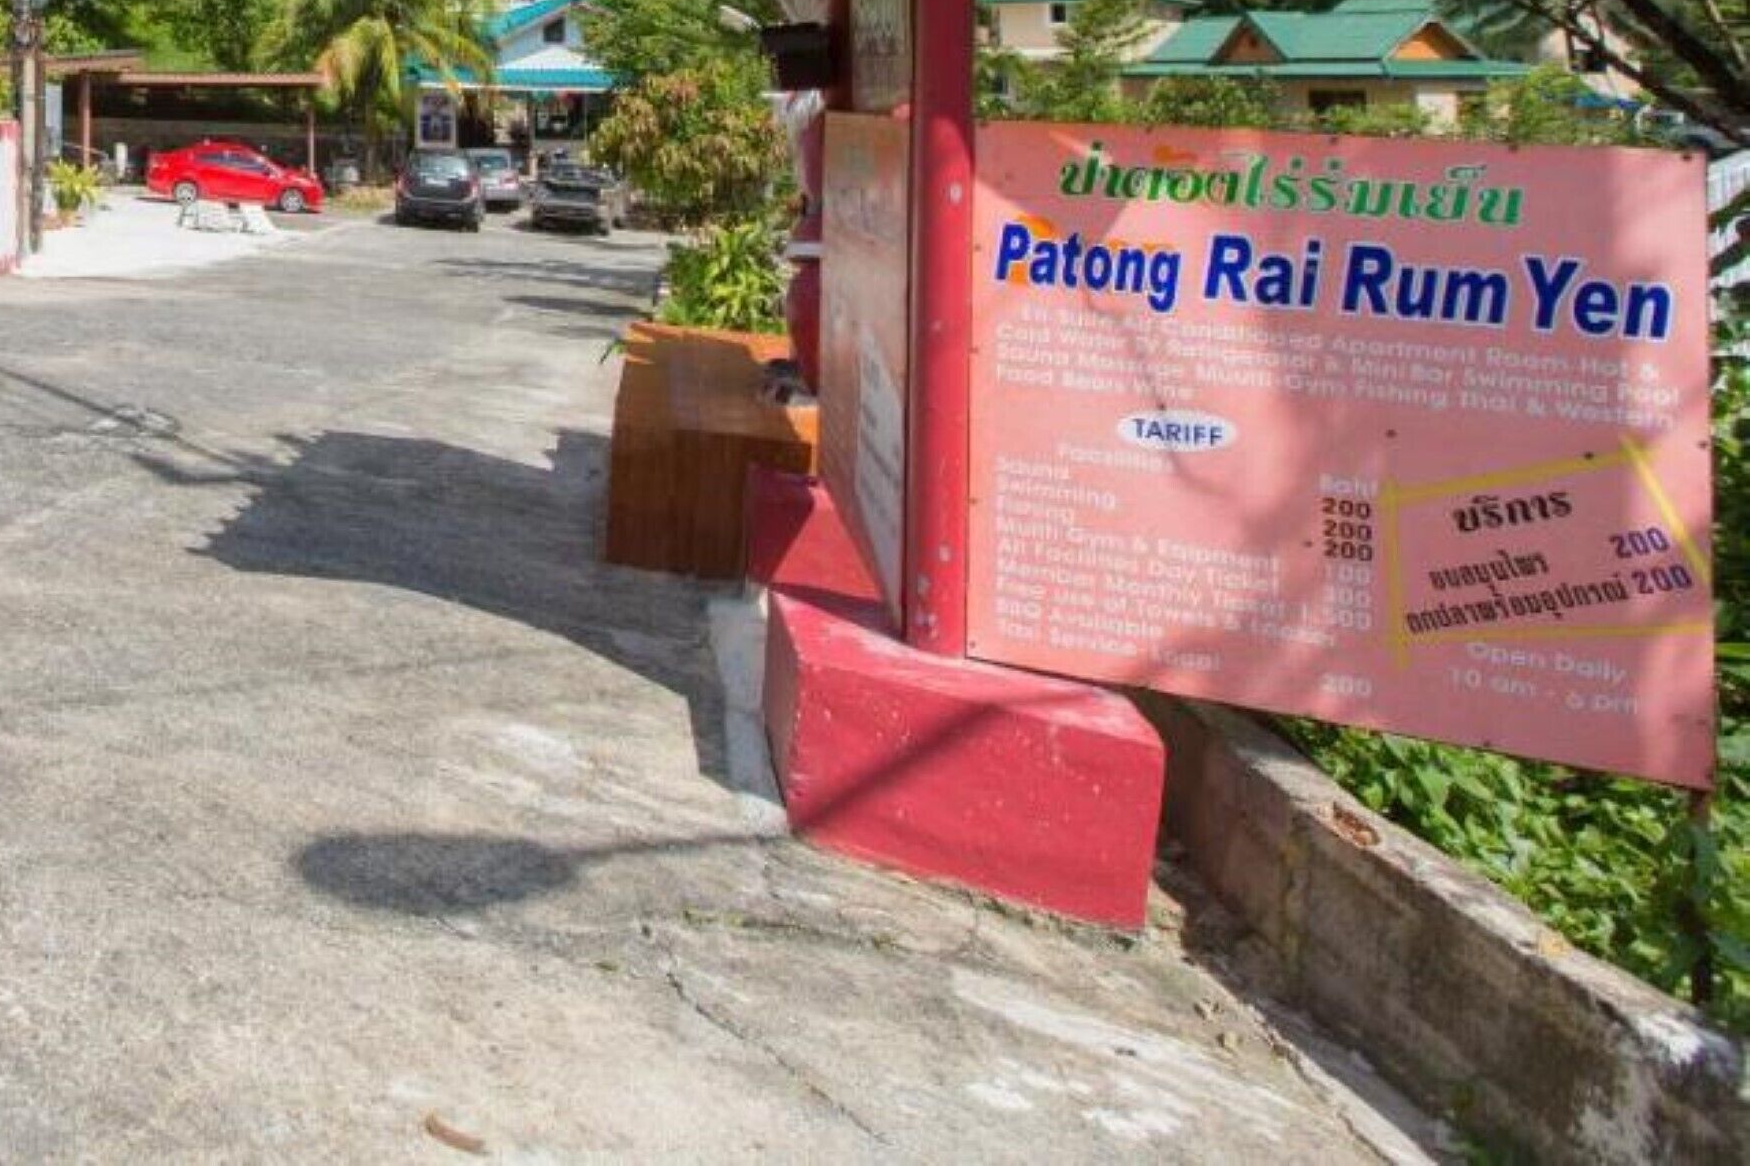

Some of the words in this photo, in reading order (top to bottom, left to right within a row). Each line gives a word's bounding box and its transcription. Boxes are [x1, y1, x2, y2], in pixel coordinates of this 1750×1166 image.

[994, 222, 1180, 314] Patong
[1204, 232, 1320, 312] Rai
[1341, 240, 1508, 326] Rum
[1522, 254, 1674, 343] Yen
[1130, 416, 1226, 449] TARIFF
[1322, 497, 1372, 520] 200
[1453, 490, 1572, 533] บริการ
[1323, 519, 1373, 542] 200
[1609, 527, 1670, 559] 200
[1324, 540, 1373, 563] 200
[1631, 564, 1693, 596] 200
[1466, 641, 1547, 670] Open
[1554, 651, 1628, 685] Daily
